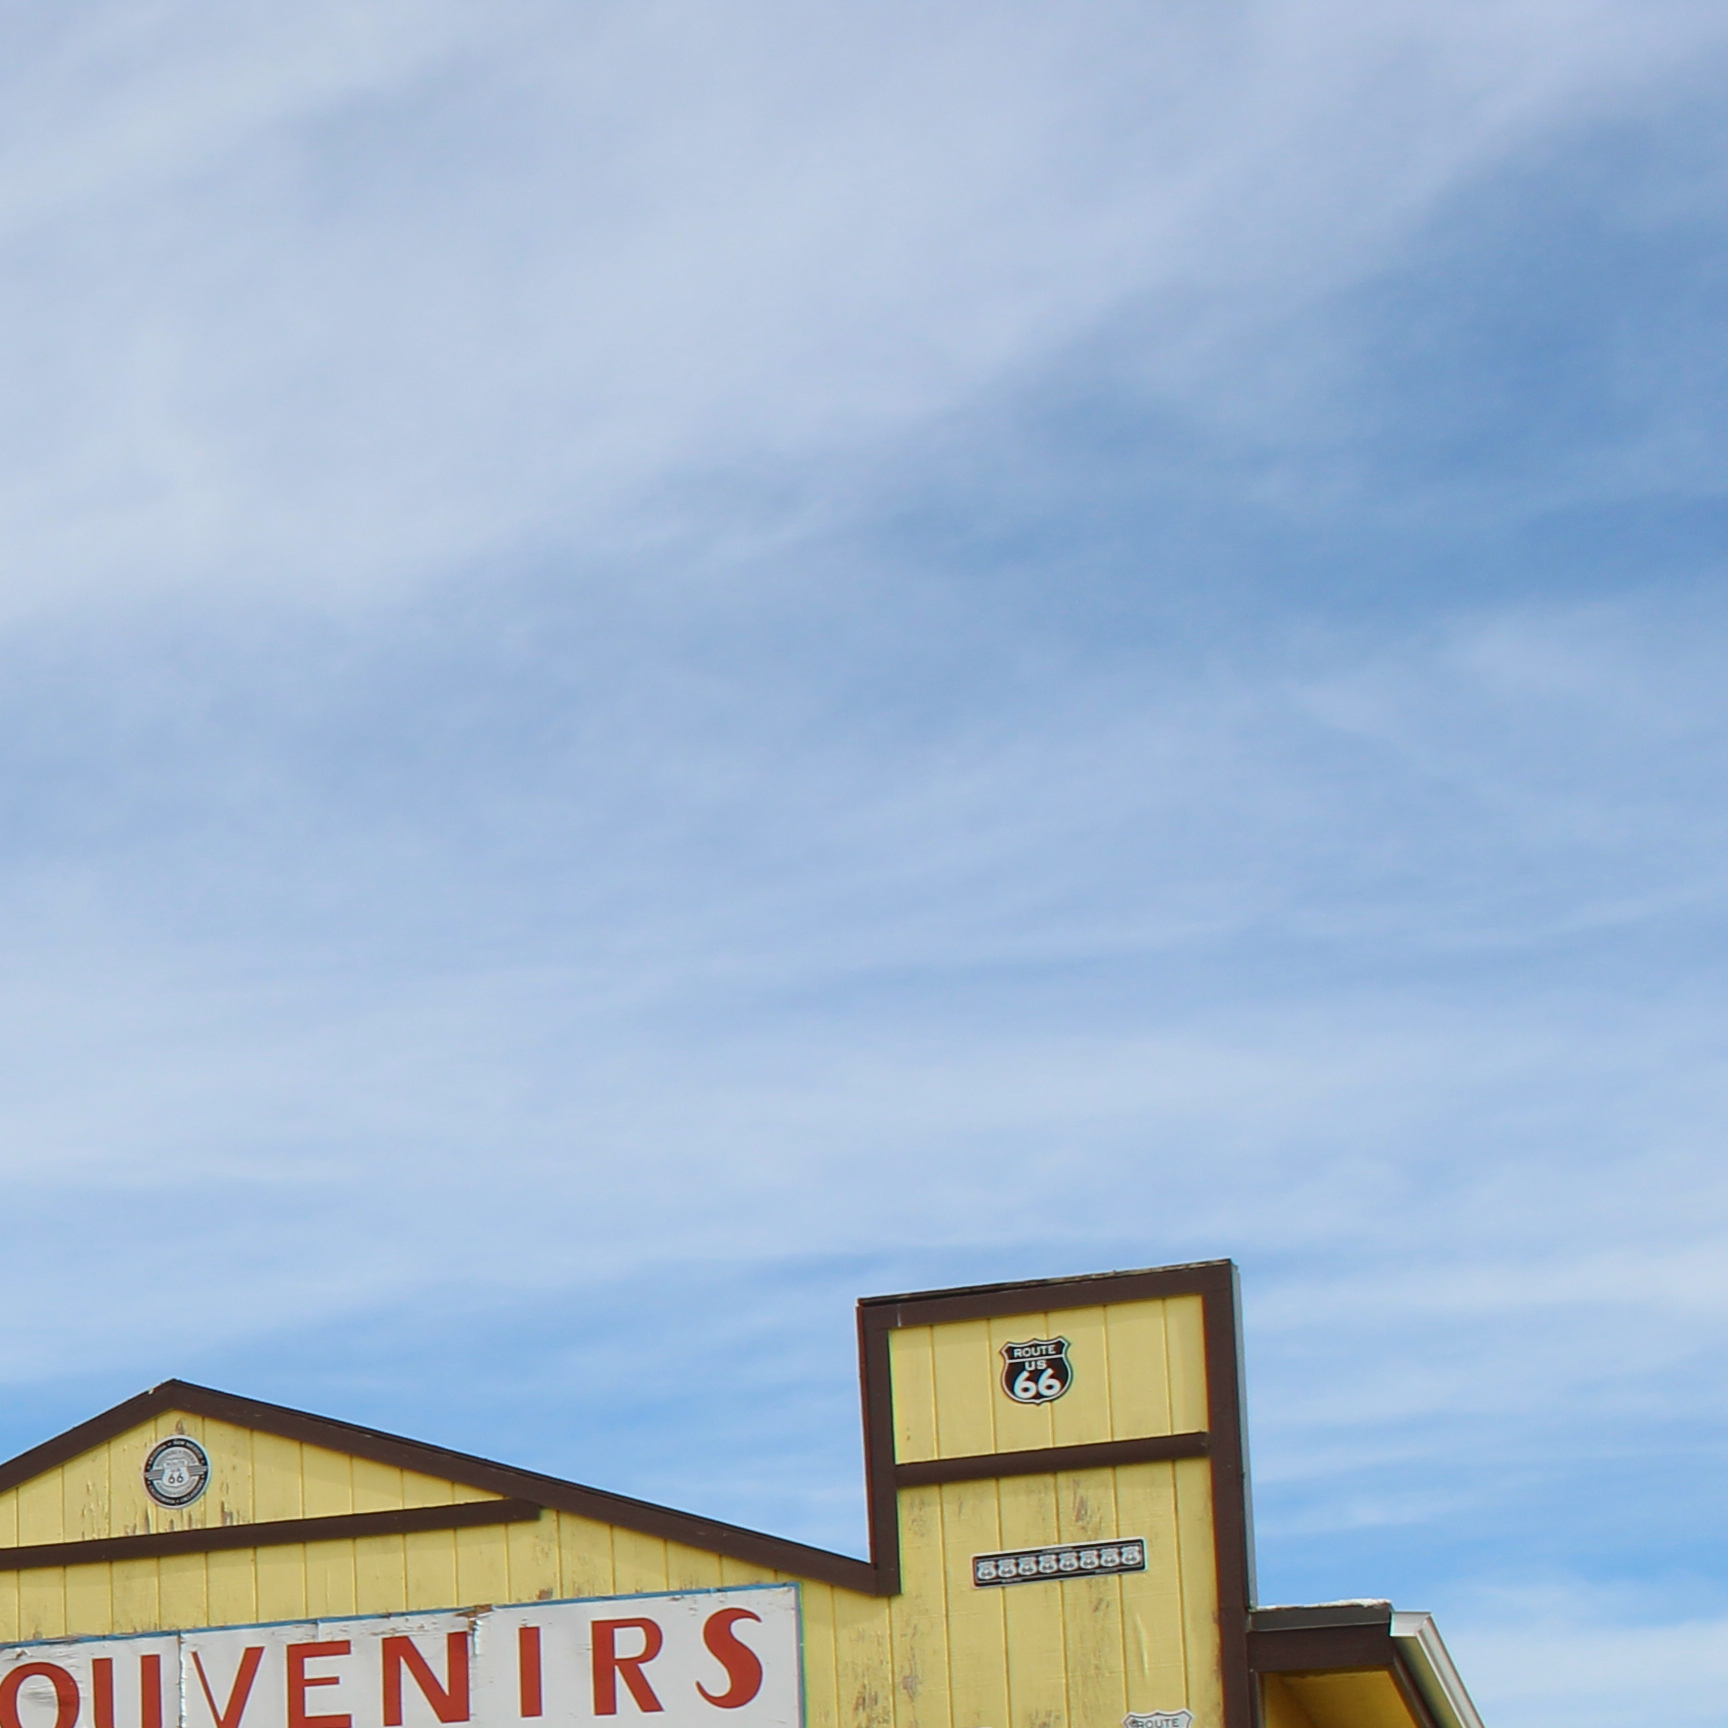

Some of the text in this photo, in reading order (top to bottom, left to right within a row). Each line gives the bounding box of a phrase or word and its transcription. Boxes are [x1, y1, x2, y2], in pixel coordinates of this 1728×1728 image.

[1013, 1344, 1056, 1358] ROUTE
[1024, 1359, 1047, 1371] US
[1013, 1368, 1062, 1399] 66
[168, 1472, 184, 1484] 66
